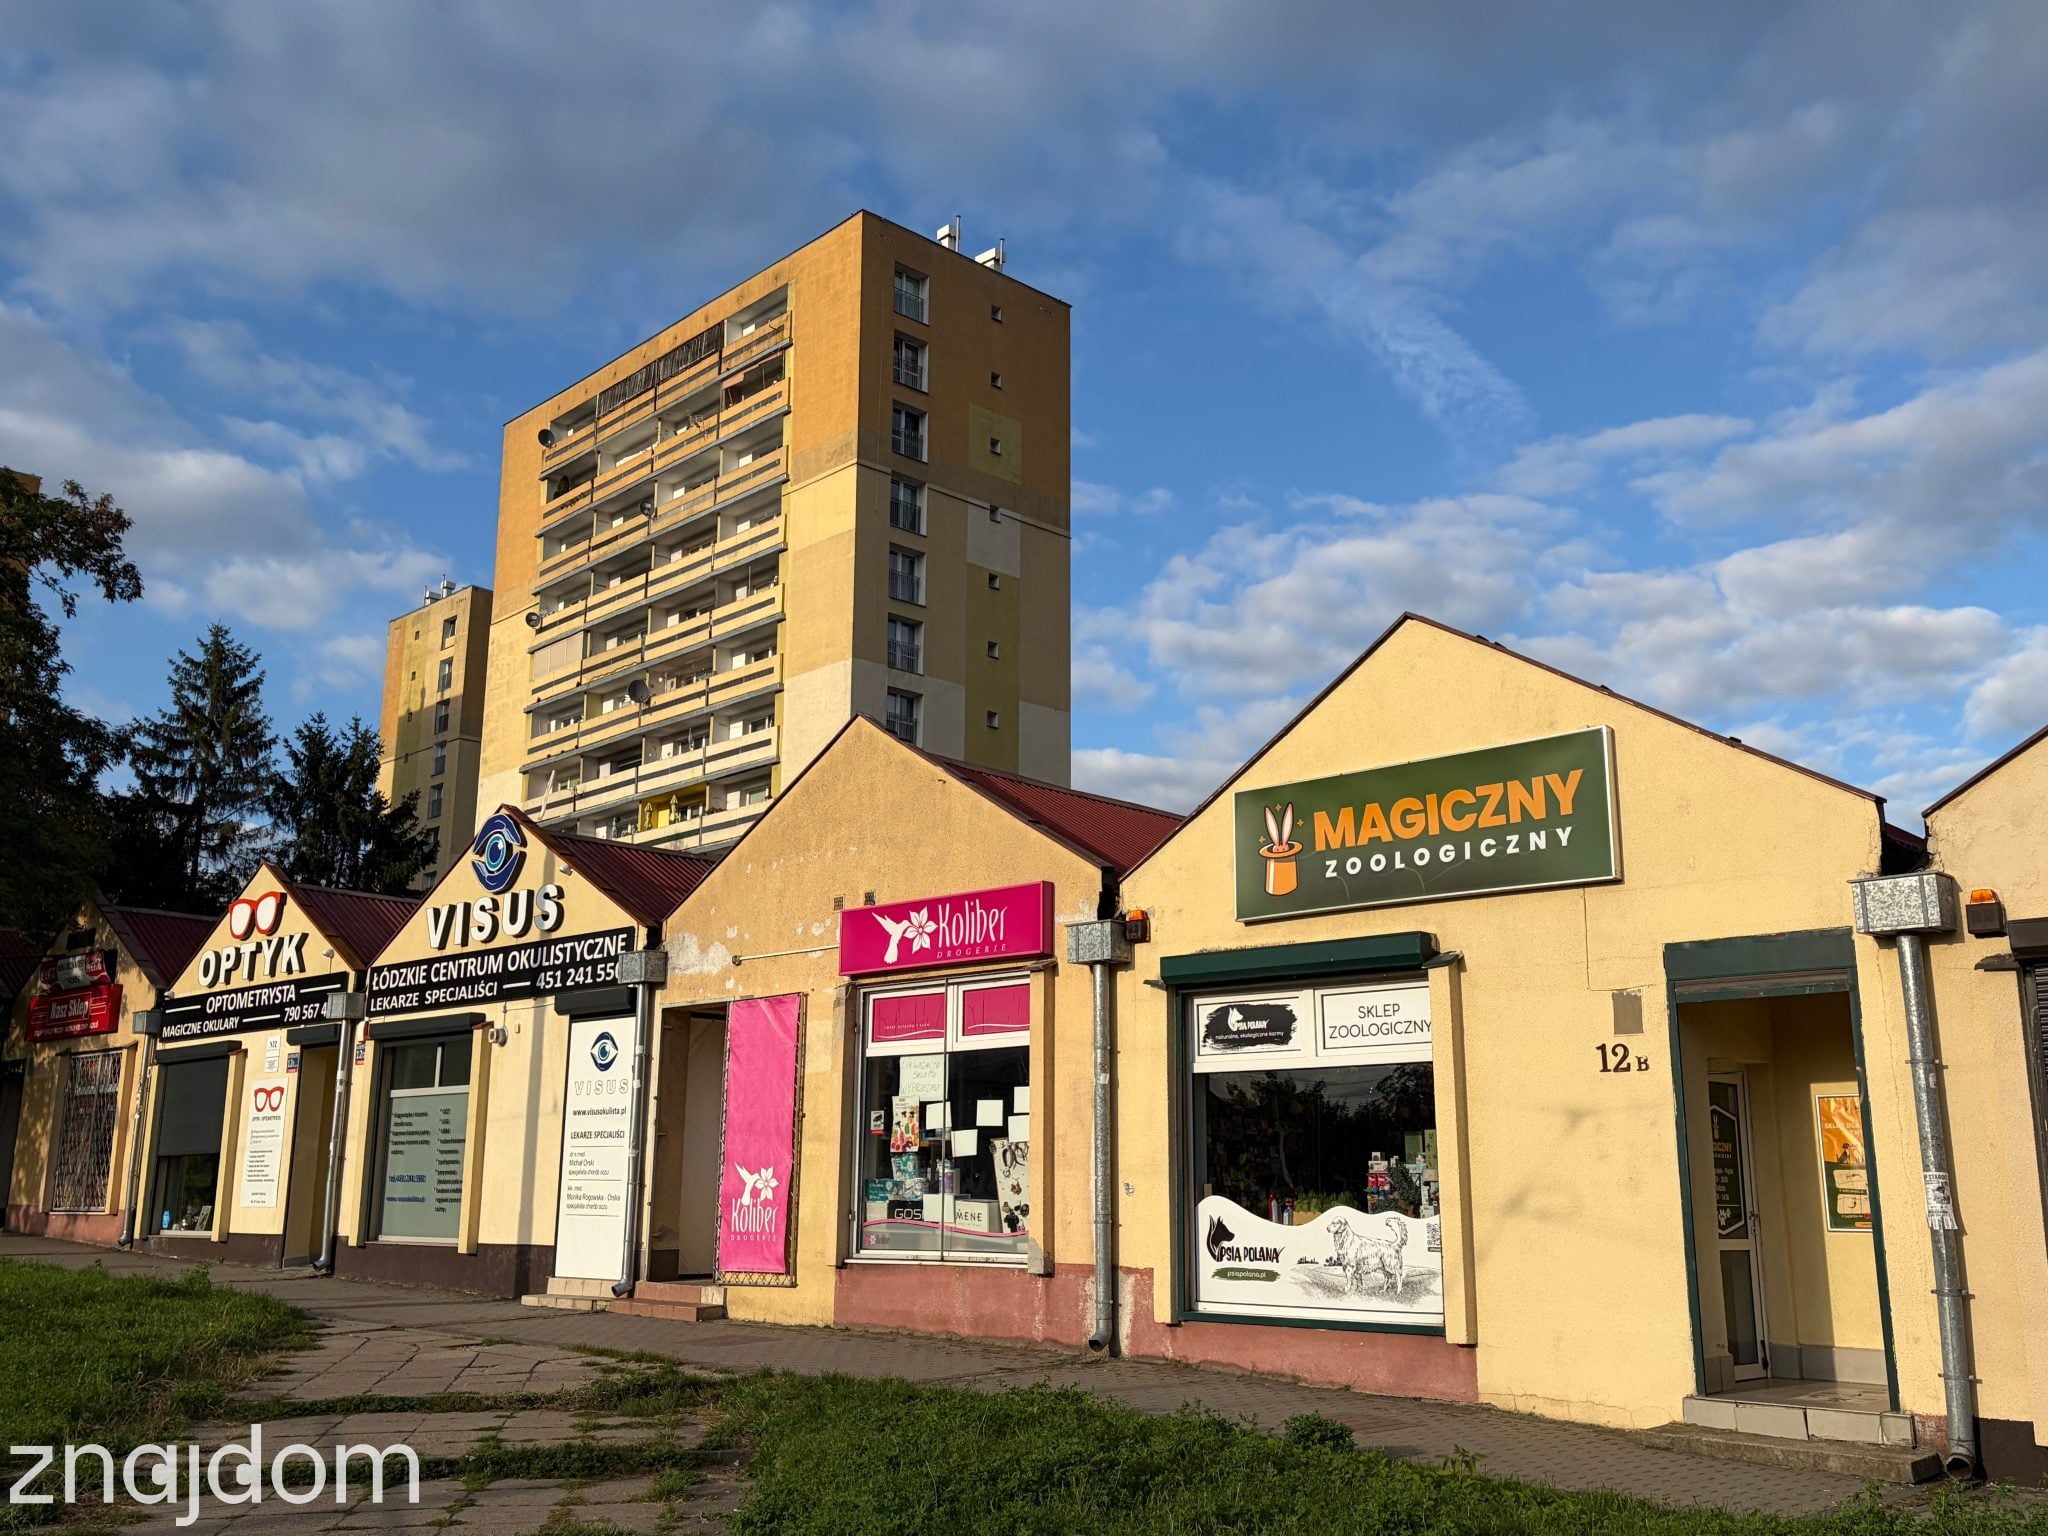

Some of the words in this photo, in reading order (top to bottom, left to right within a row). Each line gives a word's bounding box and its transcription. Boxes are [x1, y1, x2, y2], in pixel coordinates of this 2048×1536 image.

[1313, 768, 1584, 852] MAGICZNY
[1325, 826, 1573, 878] ZOOLOGICZNY
[426, 883, 562, 950] VISUS
[938, 898, 1008, 949] Koliber
[198, 932, 305, 988] OPTYK
[372, 964, 428, 992] ŁÓDZKIE
[430, 953, 504, 984] CENTRUM
[507, 933, 628, 972] OKULISTYCZNE
[937, 944, 1007, 959] DROGERIE
[206, 983, 296, 1014] OPTOMETRYSTA
[370, 993, 420, 1012] LEKARZE
[424, 979, 498, 1005] SPECJALIŚCI
[536, 970, 563, 990] 451
[566, 968, 593, 987] 241
[50, 1001, 68, 1019] Nasz
[68, 999, 89, 1019] Sklep
[162, 1021, 202, 1039] MAGICZNE
[202, 1016, 240, 1033] OKULARY
[284, 1006, 300, 1023] 790
[302, 1003, 319, 1021] 567
[1358, 1003, 1401, 1019] SKLEP
[1328, 1019, 1432, 1039] ZOOLOGICZNY
[1595, 1043, 1631, 1073] 12
[1635, 1055, 1650, 1072] B
[574, 1078, 629, 1096] VISUS
[573, 1106, 627, 1117] www.visusokulista.pl
[570, 1130, 593, 1140] LEKARZE
[593, 1128, 625, 1139] SPECJALIŚCI
[731, 1198, 779, 1233] Koliber
[894, 1208, 924, 1220] GOS
[955, 1211, 983, 1222] MENE
[1219, 1245, 1242, 1263] PSIA
[1243, 1246, 1284, 1264] POLANA
[1227, 1270, 1267, 1279] psiapolana.pl
